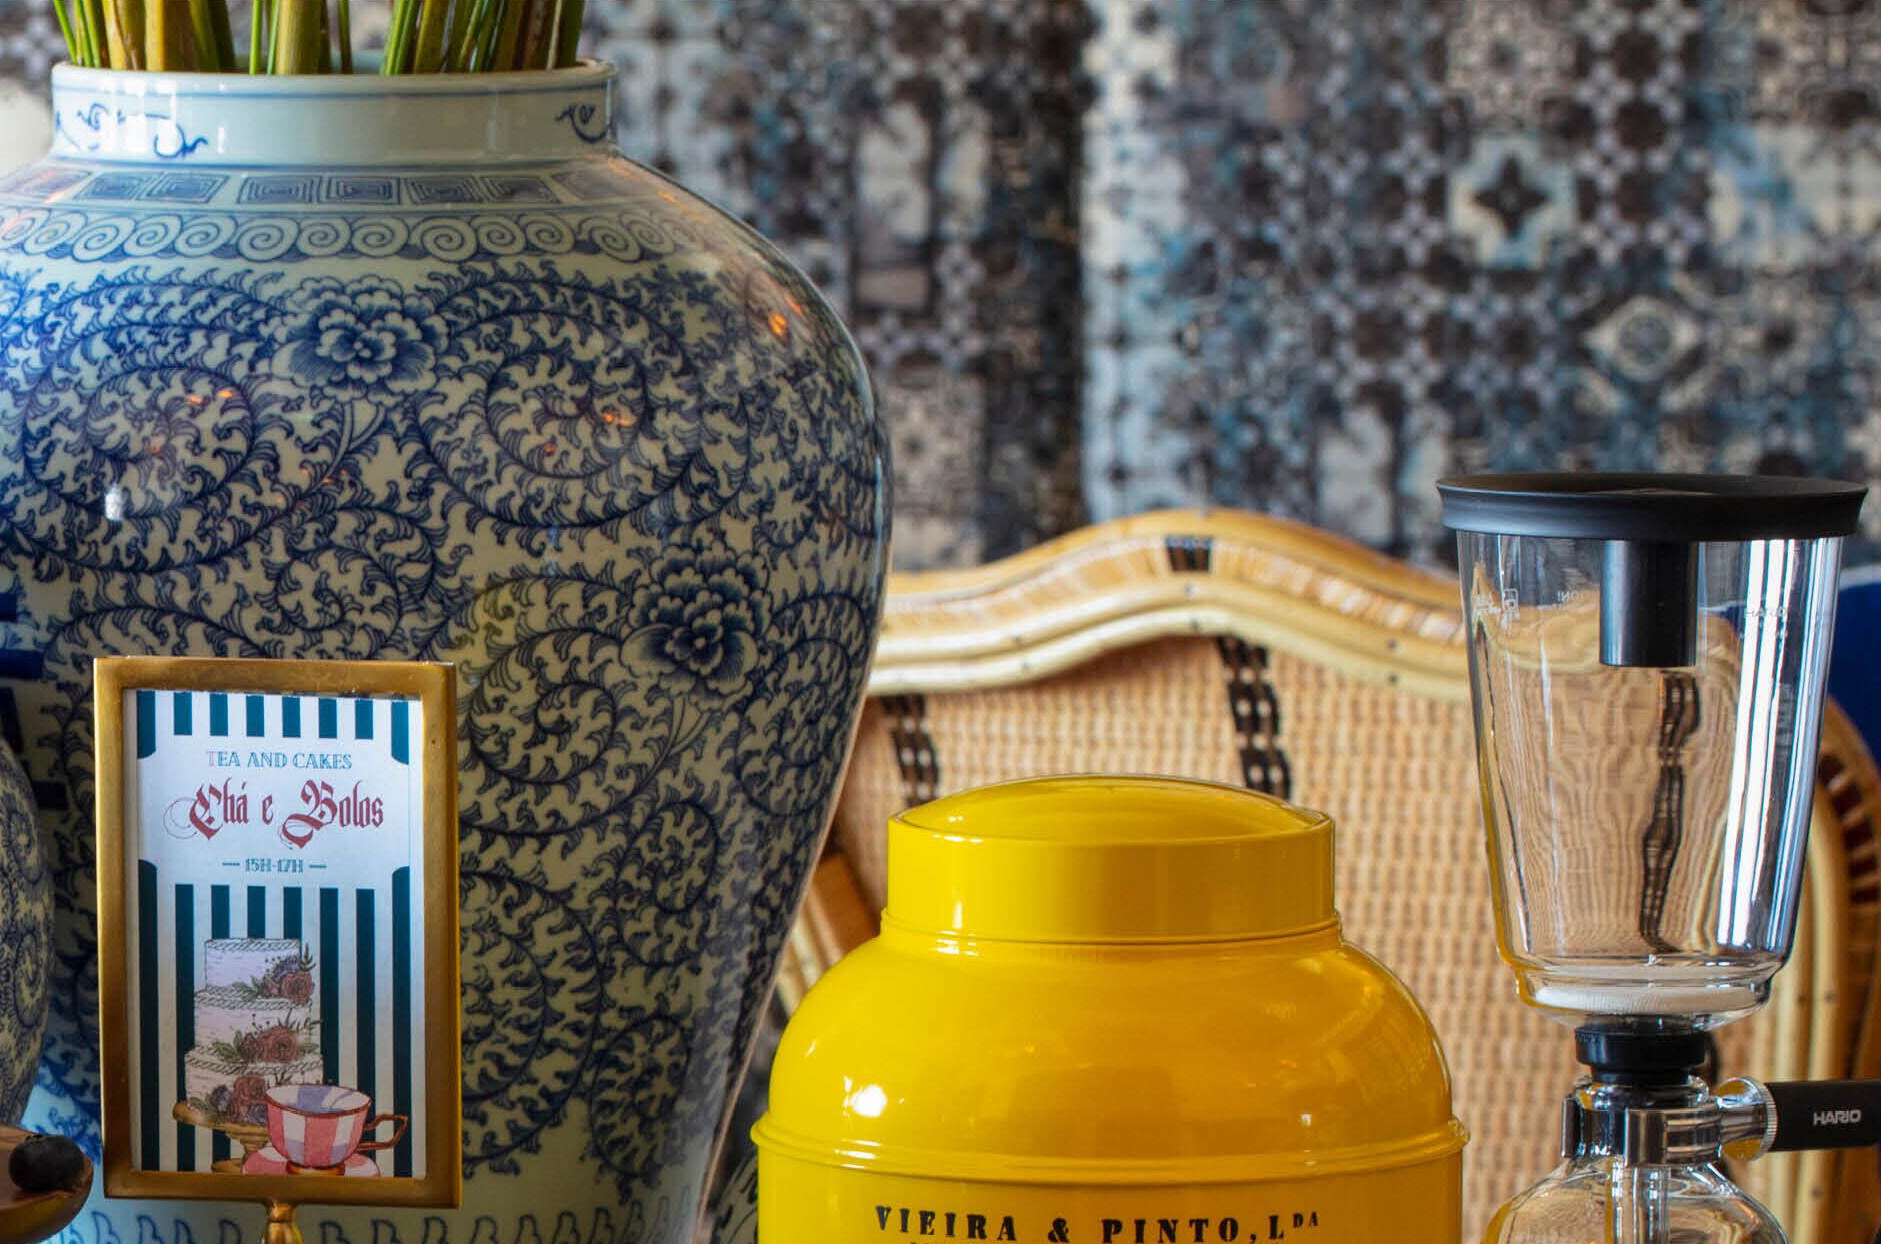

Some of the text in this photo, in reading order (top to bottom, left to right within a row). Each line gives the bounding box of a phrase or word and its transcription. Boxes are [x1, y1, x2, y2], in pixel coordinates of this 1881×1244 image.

[206, 751, 352, 770] TEA AND CAKES
[163, 777, 384, 850] Chá e Bolos
[1813, 1109, 1861, 1125] HARIO
[876, 1206, 1017, 1242] VIEIRA
[1047, 1217, 1070, 1243] &
